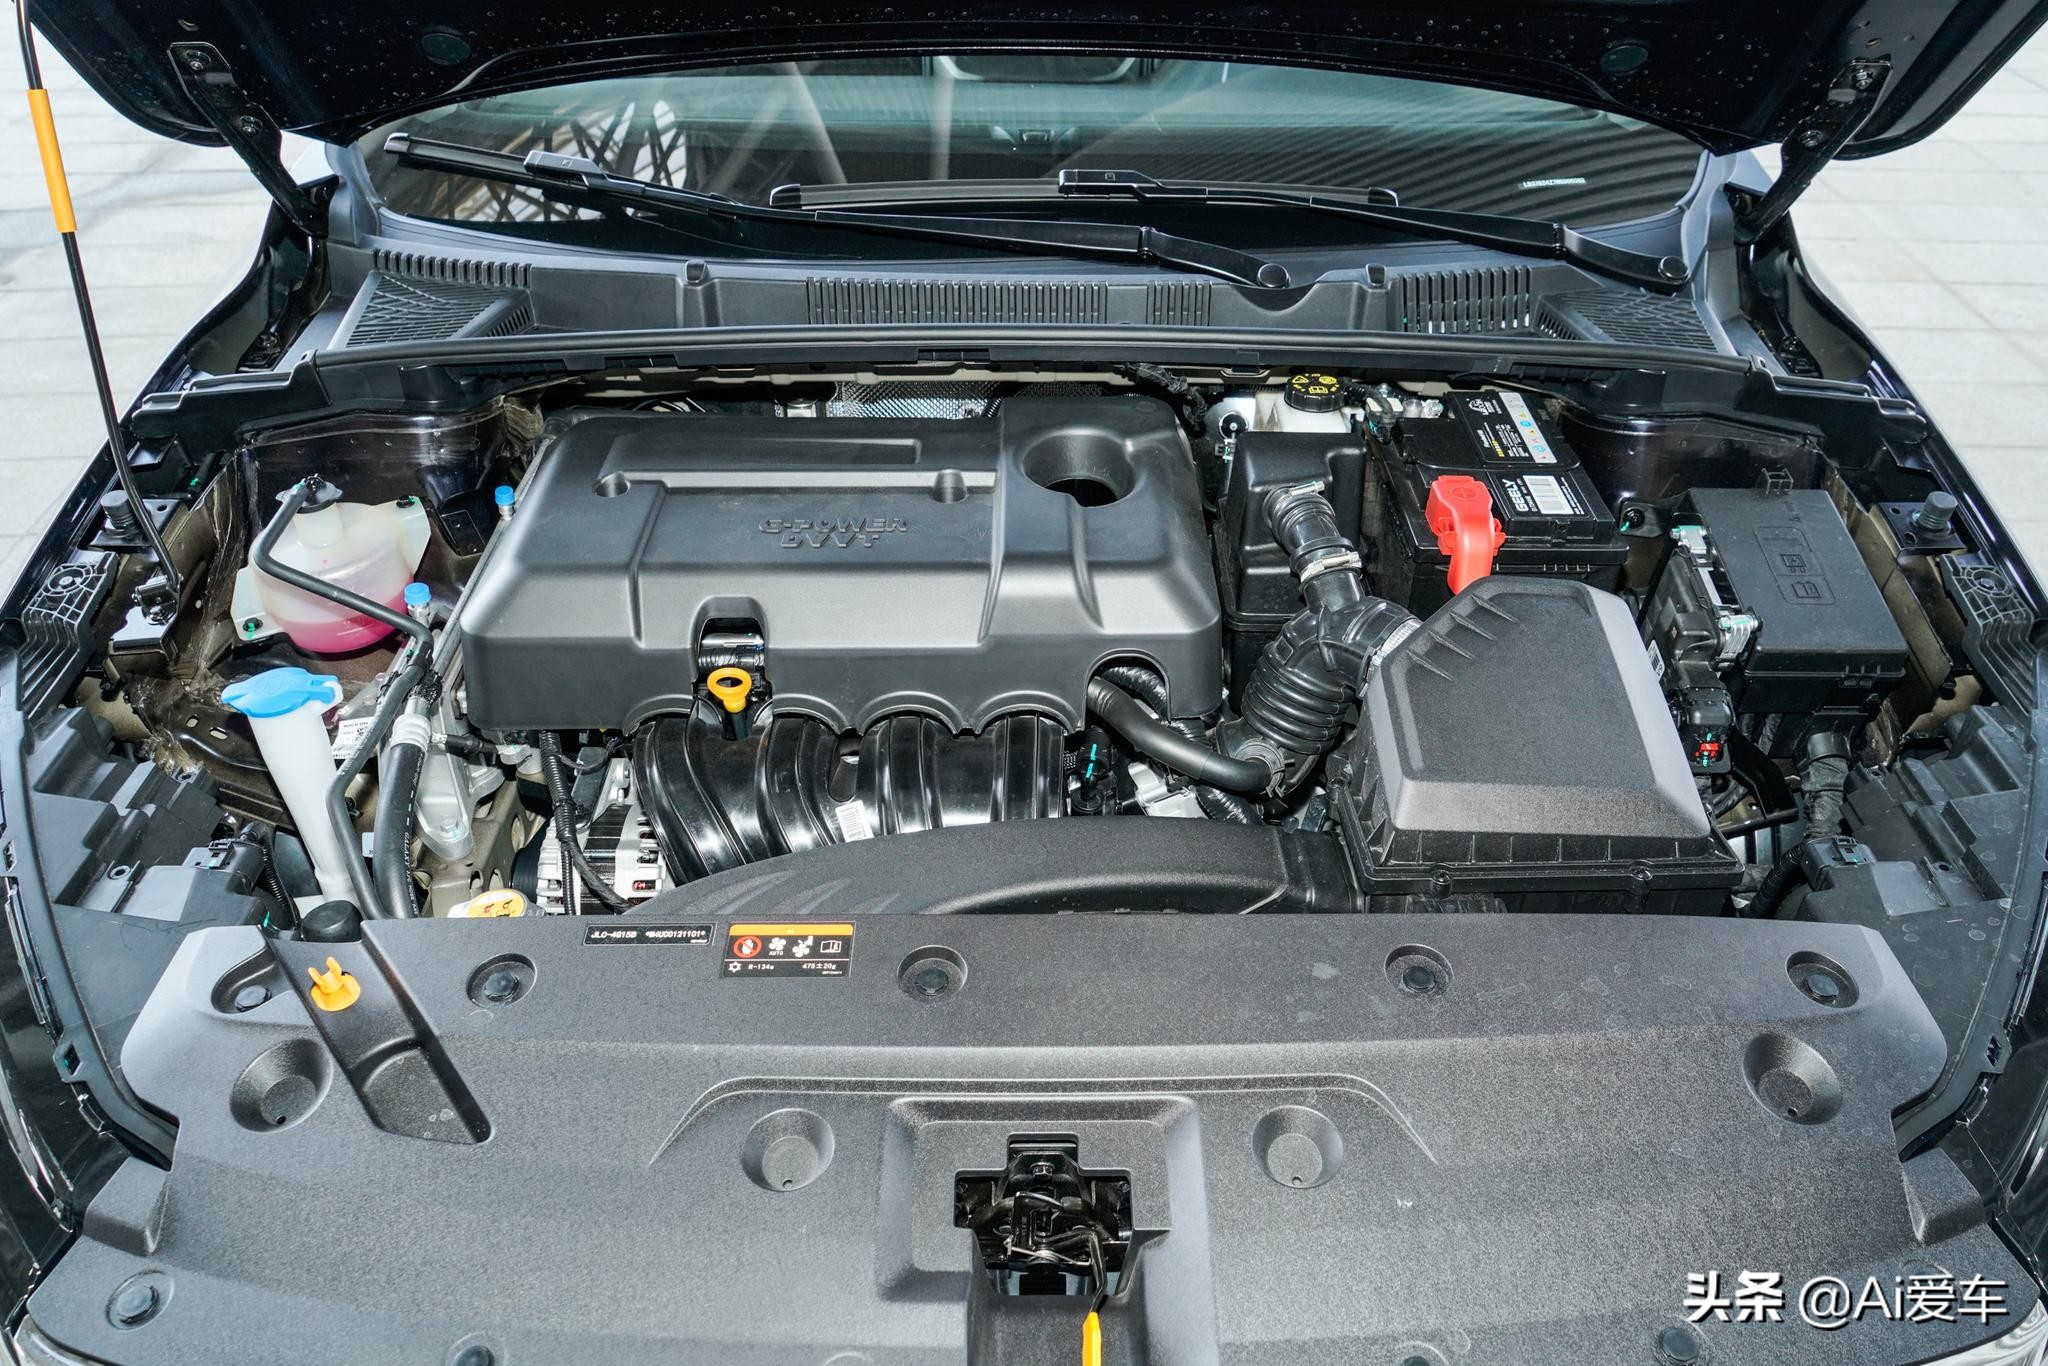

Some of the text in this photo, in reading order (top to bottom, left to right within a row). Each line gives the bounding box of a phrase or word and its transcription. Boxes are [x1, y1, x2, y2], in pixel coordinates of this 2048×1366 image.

[1502, 479, 1529, 512] GEELY
[759, 518, 907, 533] G-POWER
[780, 533, 880, 548] DVVT
